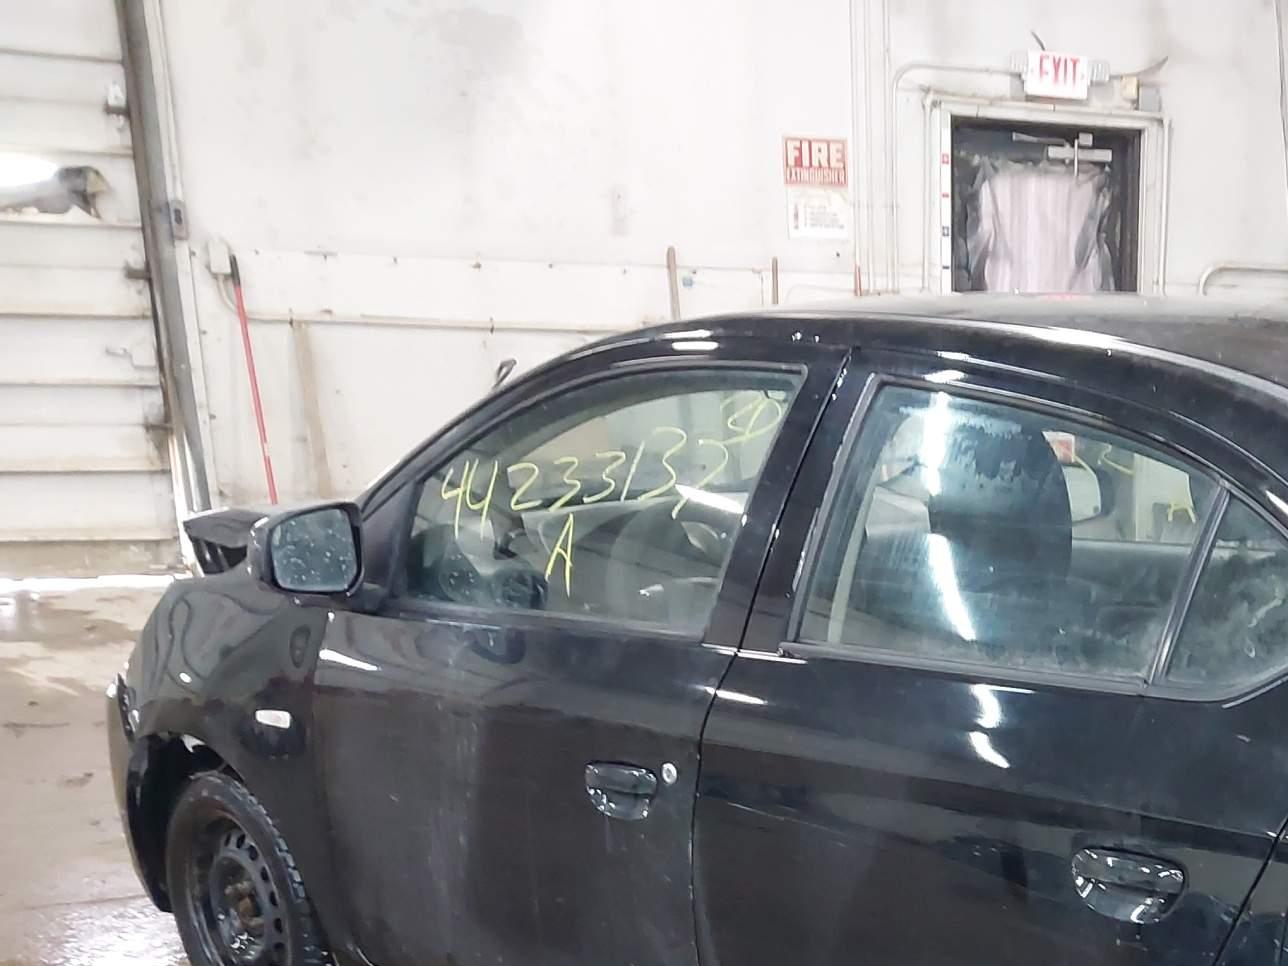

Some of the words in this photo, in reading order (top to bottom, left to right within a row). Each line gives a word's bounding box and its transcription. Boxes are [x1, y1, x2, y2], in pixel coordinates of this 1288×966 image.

[1039, 54, 1081, 87] EXIT
[785, 139, 845, 168] FIRE
[785, 167, 847, 185] EXTINGUISHER
[544, 512, 575, 598] A
